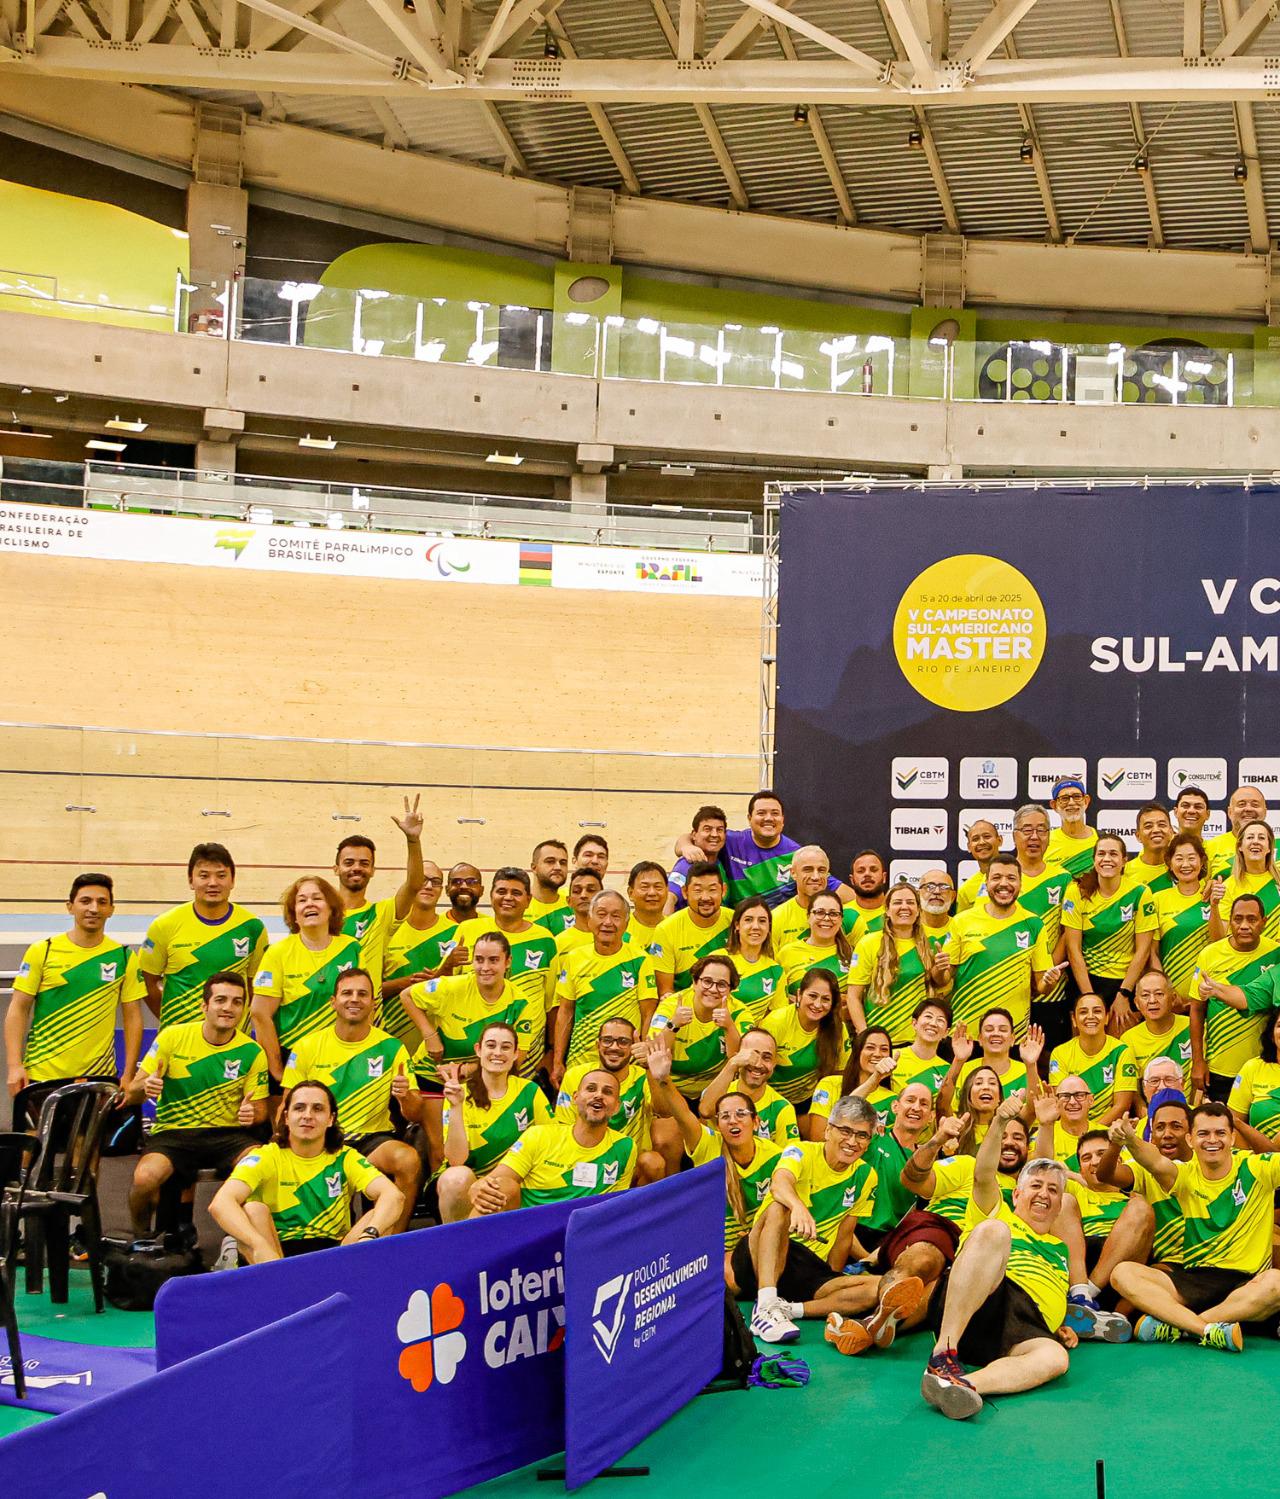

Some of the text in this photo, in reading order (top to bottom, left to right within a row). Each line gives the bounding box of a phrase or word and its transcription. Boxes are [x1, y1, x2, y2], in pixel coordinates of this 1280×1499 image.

[0, 511, 89, 526] ONFEDERAÇÃO
[0, 524, 83, 539] RASILEIRA DE
[0, 538, 50, 550] ICLISMO
[268, 538, 320, 550] COMITÊ
[268, 549, 345, 563] BRASILEIRO
[920, 595, 928, 603] 15
[938, 595, 949, 603] 20
[951, 594, 963, 603] de
[965, 594, 984, 603] abril
[986, 594, 997, 602] de
[999, 594, 1022, 602] 2025
[1200, 578, 1238, 615] V
[908, 608, 1034, 621] V CAMPEONATO
[907, 622, 1033, 635] SUL-AMERICANO
[906, 636, 1033, 660] MASTER
[917, 665, 1021, 673] RIO DE JANEIRO
[920, 771, 945, 779] CBTM
[1032, 775, 1066, 783] TIBHA
[1127, 772, 1152, 780] CBTM
[1242, 775, 1278, 783] TIBHAR
[977, 778, 1000, 789] RIO
[895, 826, 930, 835] TIBHAR
[1203, 824, 1223, 832] BTM
[634, 1253, 671, 1287] POLO DE
[479, 1251, 565, 1315] loteri
[634, 1254, 708, 1309] DESENVOLVIMENTO
[634, 1293, 677, 1330] REGIONAL
[633, 1325, 657, 1348] by CBTM
